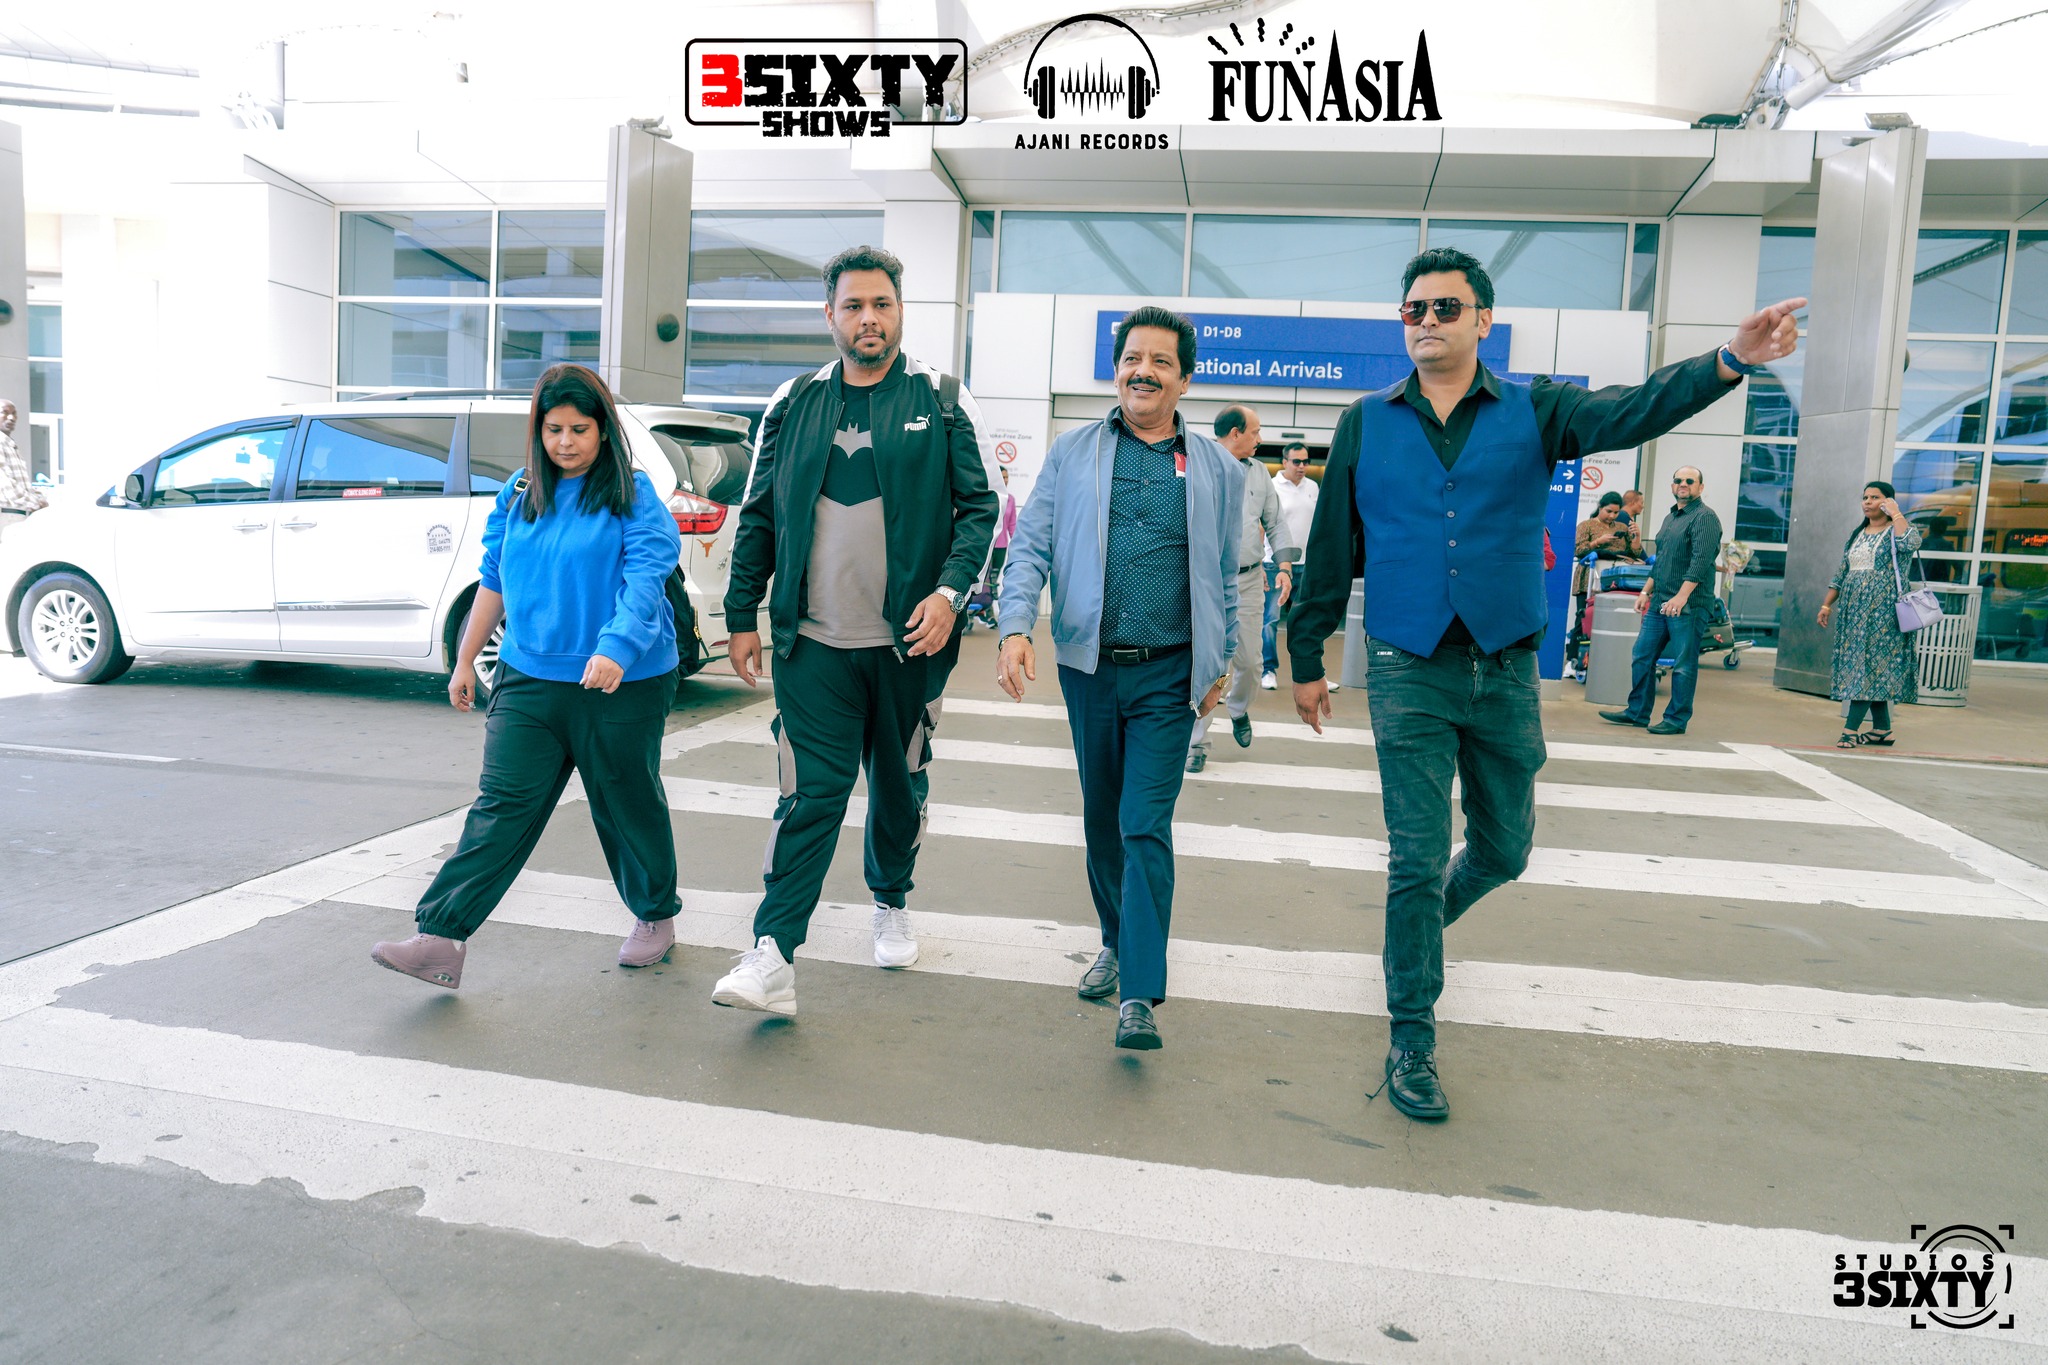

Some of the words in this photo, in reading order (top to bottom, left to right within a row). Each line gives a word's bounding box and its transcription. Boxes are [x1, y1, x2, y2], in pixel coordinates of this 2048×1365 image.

[1203, 325, 1242, 338] D1-D8
[1194, 357, 1261, 376] ational
[1268, 360, 1343, 379] Arrivals
[904, 421, 928, 432] PUMA
